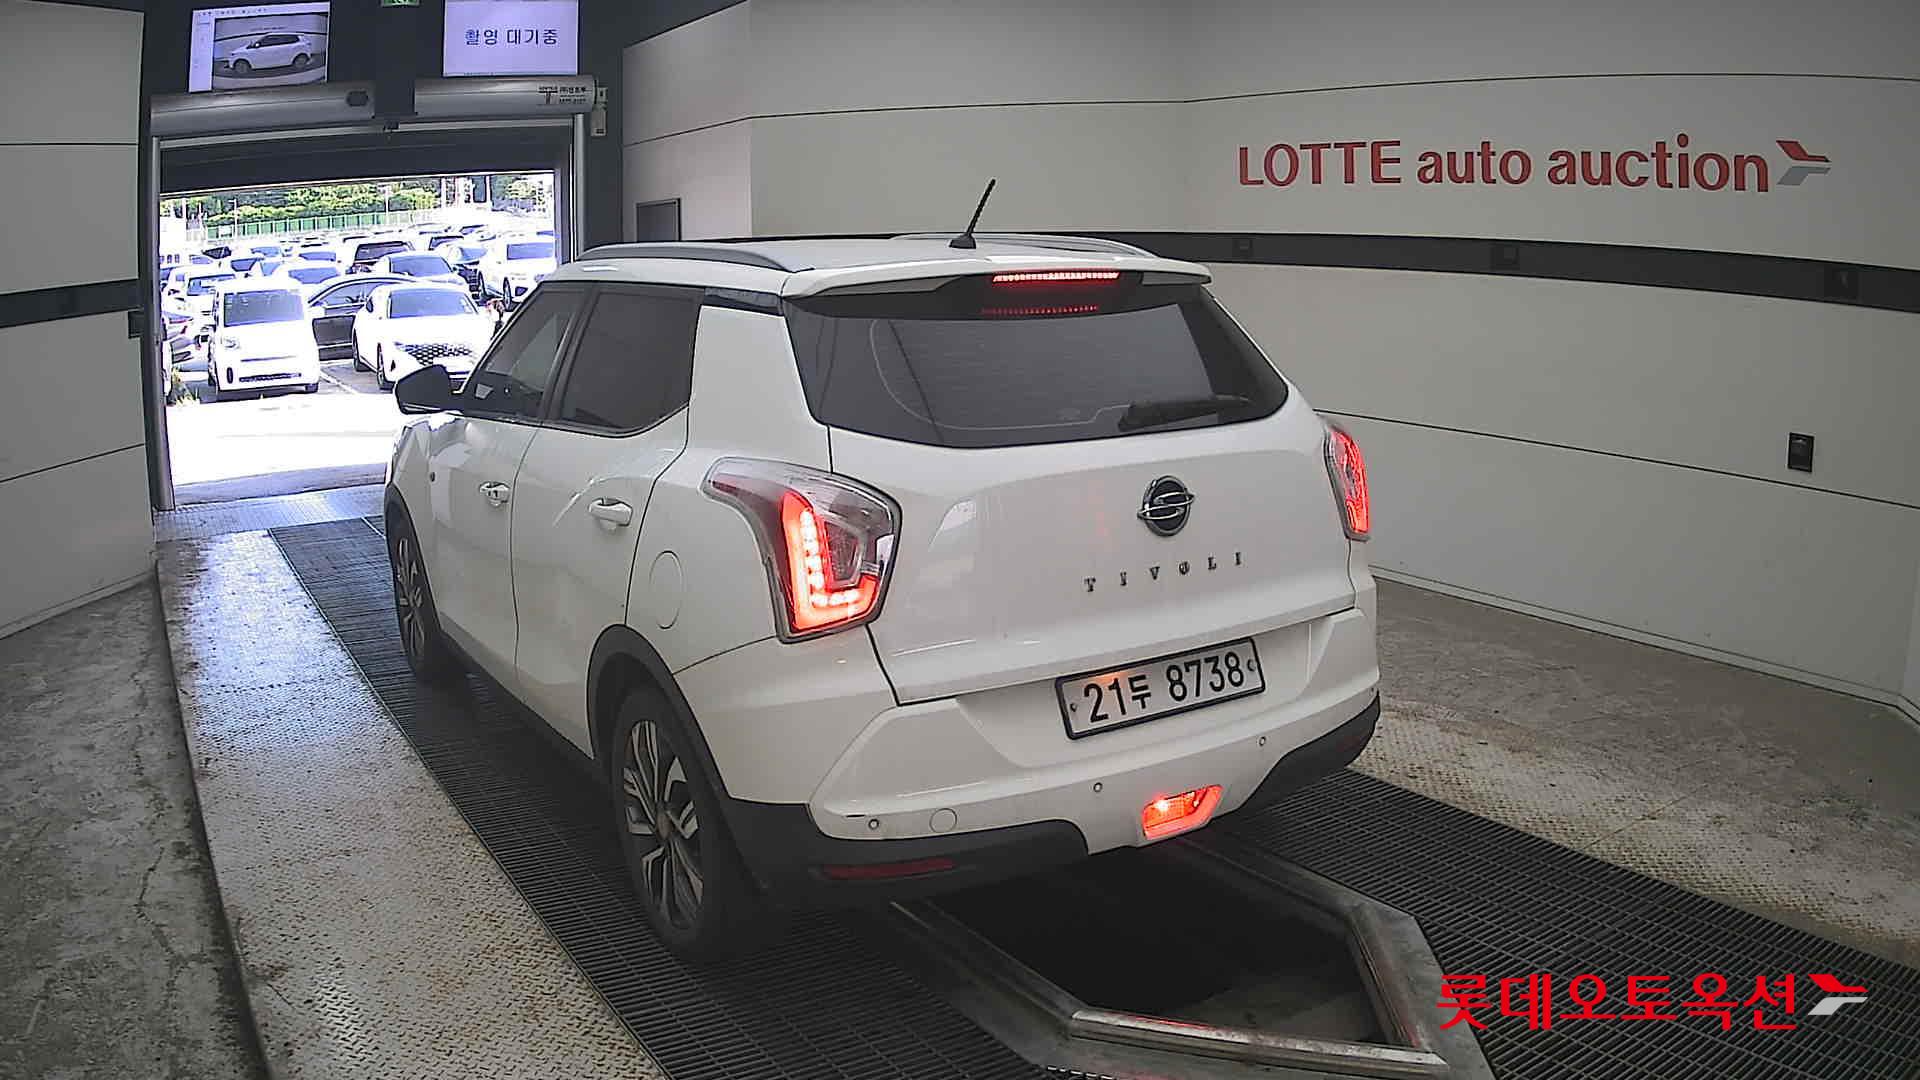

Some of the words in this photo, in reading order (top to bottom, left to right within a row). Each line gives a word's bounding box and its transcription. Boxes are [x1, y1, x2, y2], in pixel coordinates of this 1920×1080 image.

[506, 28, 558, 46] 대기중
[1239, 140, 1402, 187] LOTTE
[1416, 141, 1532, 185] auto
[1547, 133, 1769, 193] auction
[1083, 551, 1242, 593] TIVOLI
[1083, 674, 1152, 723] 21두
[1165, 651, 1244, 702] 8738
